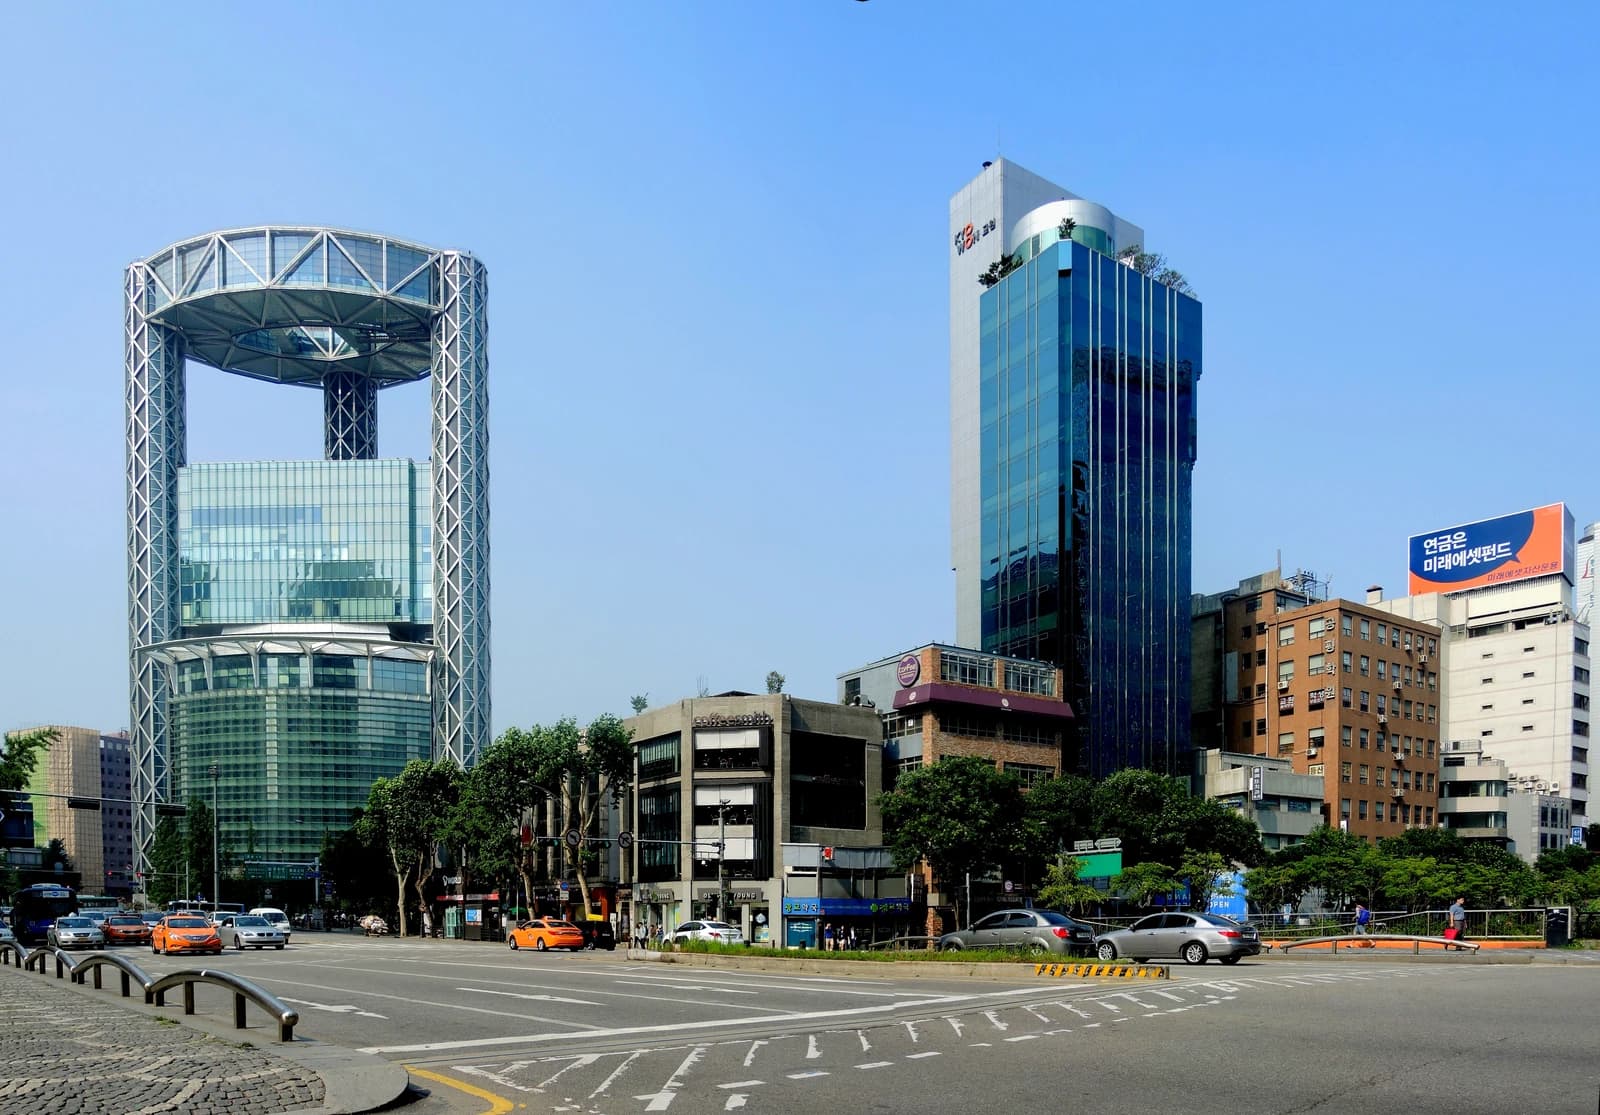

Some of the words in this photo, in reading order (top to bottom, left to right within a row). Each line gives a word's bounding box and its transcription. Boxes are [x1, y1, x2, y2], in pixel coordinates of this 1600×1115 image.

[955, 223, 974, 246] KYO
[1423, 531, 1468, 555] 연금은
[1423, 542, 1513, 573] 미래에셋펀드
[1486, 560, 1560, 582] 미래에셋자산운용
[1324, 616, 1337, 700] 공평학원
